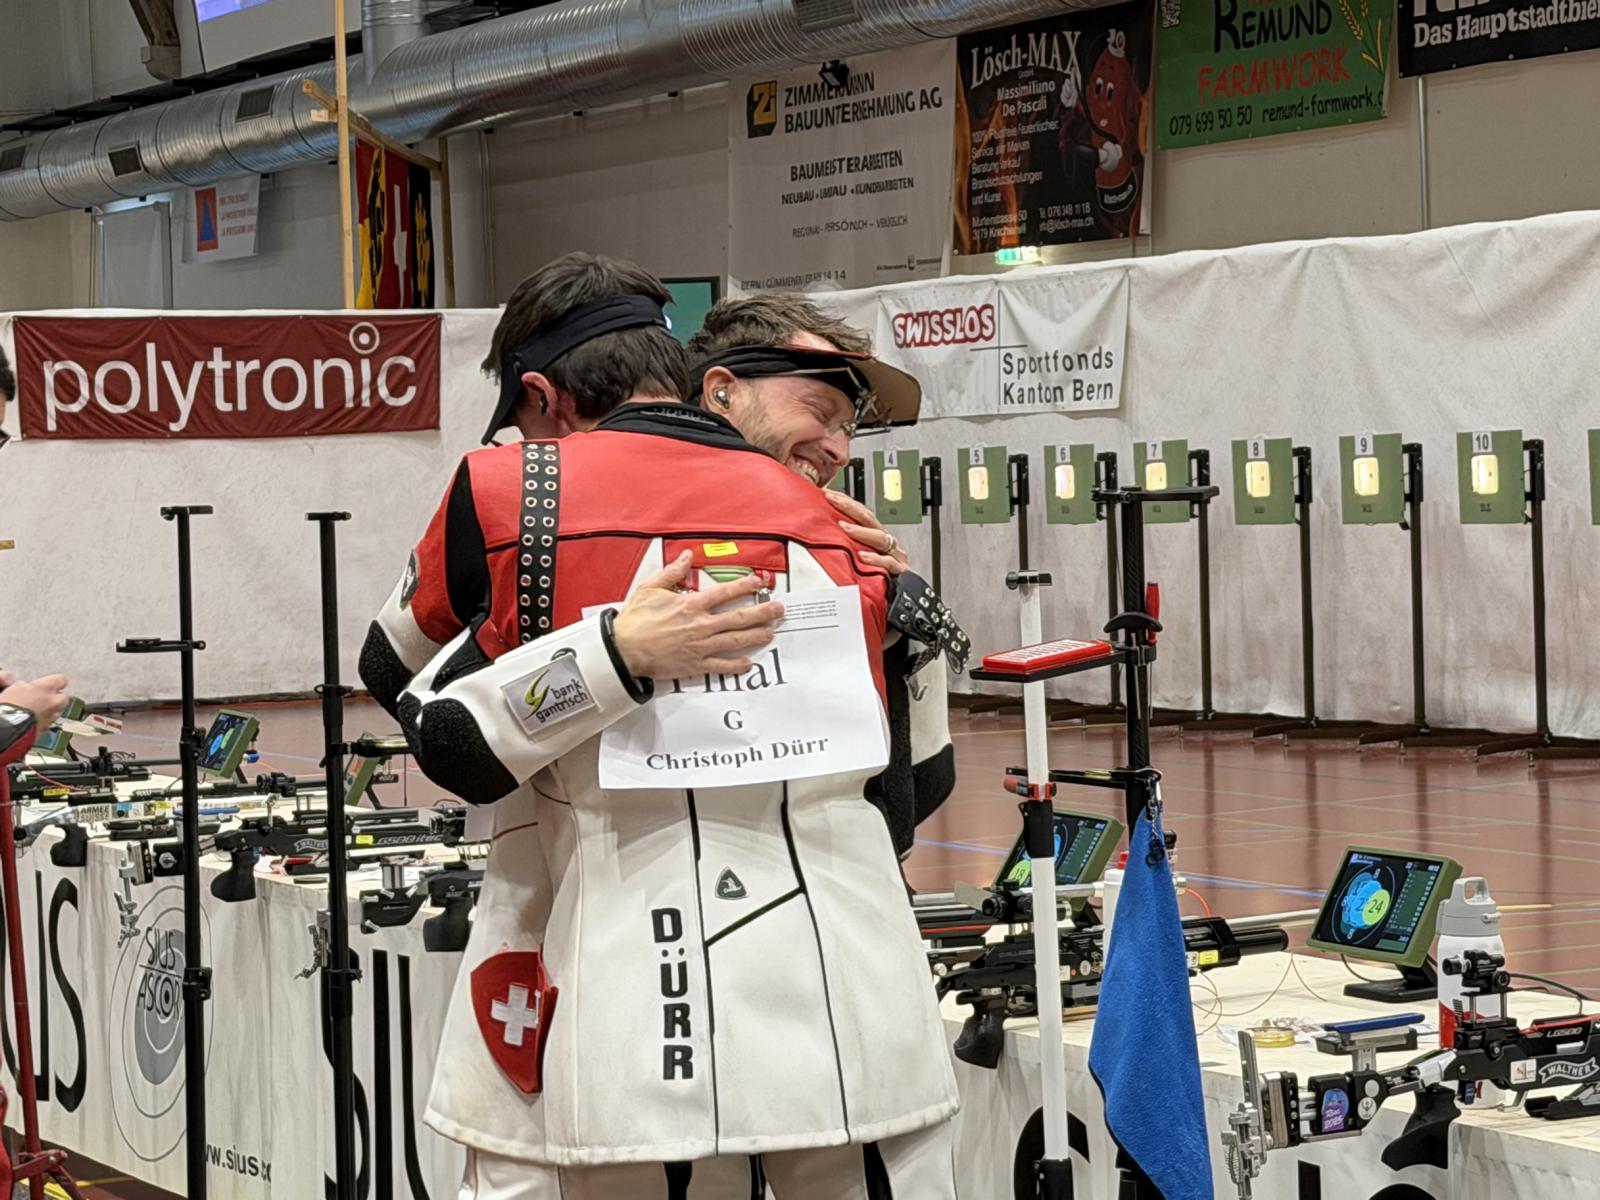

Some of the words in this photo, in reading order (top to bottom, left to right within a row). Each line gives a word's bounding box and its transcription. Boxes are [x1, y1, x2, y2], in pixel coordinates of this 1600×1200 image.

[1214, 0, 1332, 53] REMUND
[1413, 23, 1452, 47] Das
[970, 31, 1082, 89] Lösch-MAX
[1197, 45, 1352, 107] FARMWORK
[919, 86, 943, 111] AG
[997, 79, 1056, 101] Massimiliano
[1002, 101, 1016, 117] De
[1168, 116, 1192, 137] 079
[1195, 110, 1214, 132] 699
[1217, 107, 1233, 129] 50
[1237, 104, 1253, 126] 50
[893, 303, 996, 349] SWISSLOS
[1002, 346, 1114, 380] Sportfonds
[43, 321, 417, 432] polytronic
[1003, 382, 1064, 406] Kanton
[1072, 378, 1114, 402] Bern
[1150, 443, 1158, 457] 7
[1252, 441, 1260, 456] 8
[1359, 437, 1369, 453] 9
[1475, 432, 1490, 450] 10
[887, 452, 895, 466] 4
[973, 450, 981, 464] 5
[1059, 447, 1067, 462] 6
[550, 678, 583, 700] bank
[535, 690, 588, 723] gantrisch
[722, 709, 744, 731] G
[646, 747, 763, 771] Christoph
[772, 737, 829, 760] Dürr
[80, 805, 110, 814] ARMEE
[1368, 898, 1385, 915] 24
[145, 926, 176, 970] SIUS
[137, 972, 182, 1021] ASCOR
[651, 907, 694, 1081] DÜRR
[1547, 1063, 1591, 1078] WALTHER
